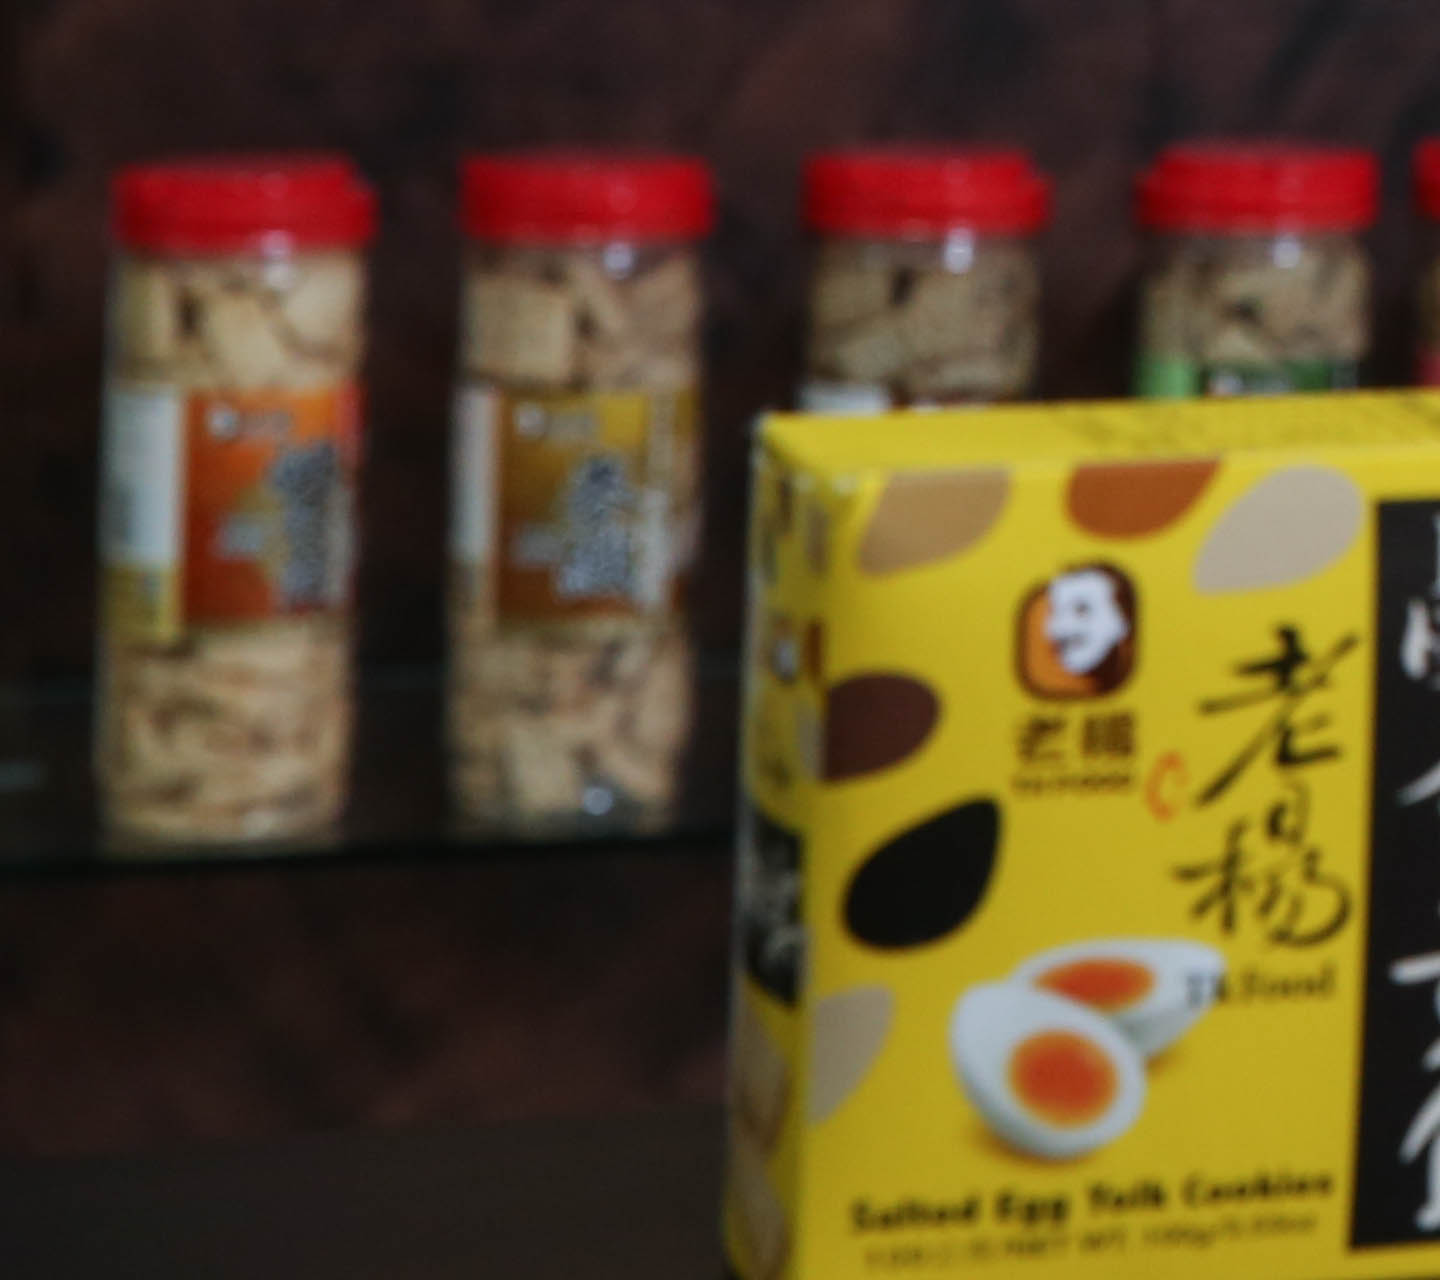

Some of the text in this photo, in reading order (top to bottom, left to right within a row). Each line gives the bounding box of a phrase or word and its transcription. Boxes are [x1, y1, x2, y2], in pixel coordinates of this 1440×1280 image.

[850, 1192, 980, 1234] Salted
[993, 1184, 1071, 1230] Egg
[1180, 1168, 1336, 1210] Cookies
